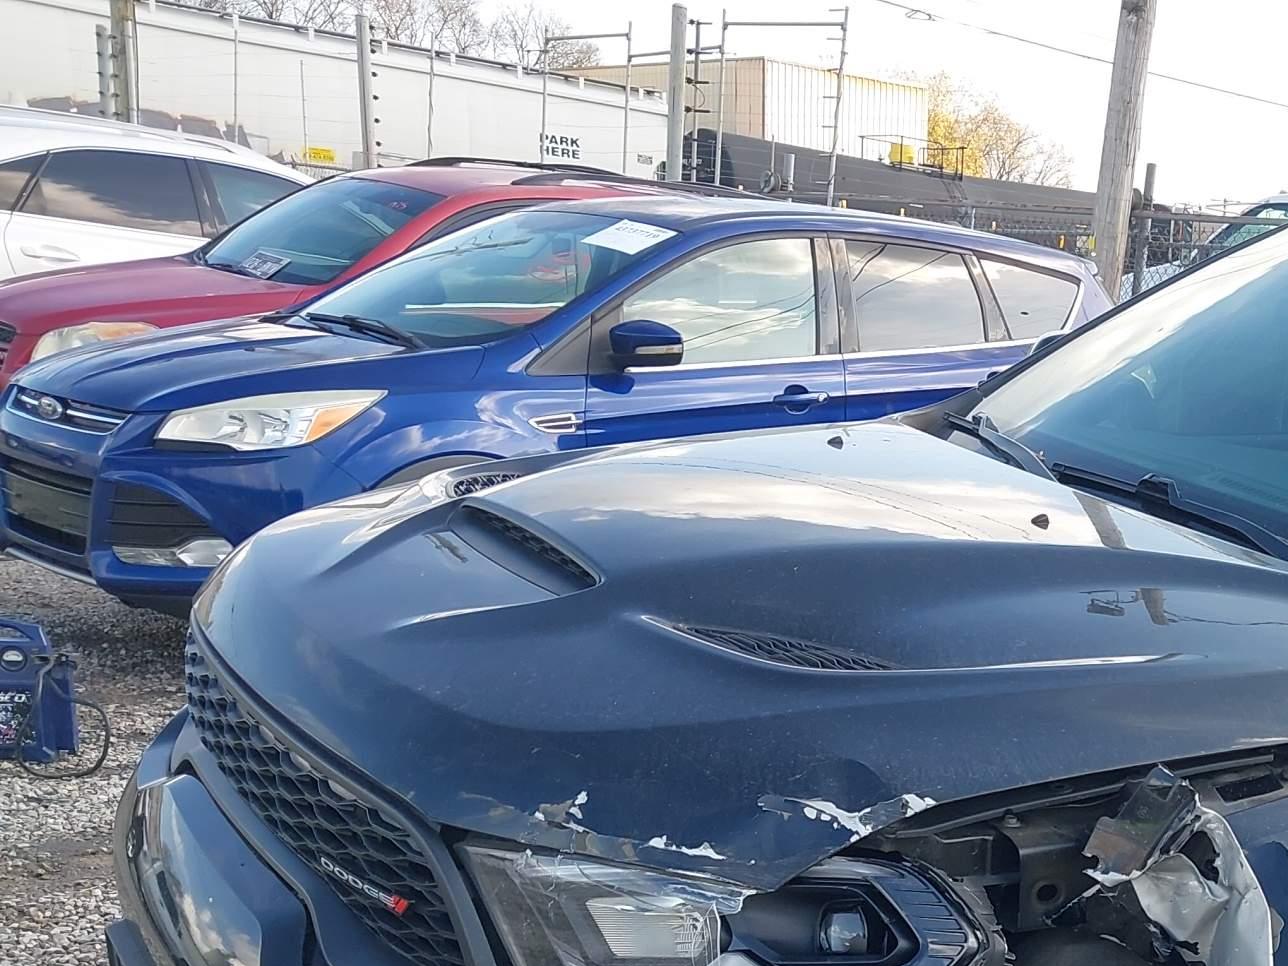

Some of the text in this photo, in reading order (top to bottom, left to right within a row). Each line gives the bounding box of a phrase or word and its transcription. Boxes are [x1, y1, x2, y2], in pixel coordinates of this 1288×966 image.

[539, 132, 580, 149] PARK
[539, 144, 581, 159] HERE
[320, 857, 396, 908] DODGE
